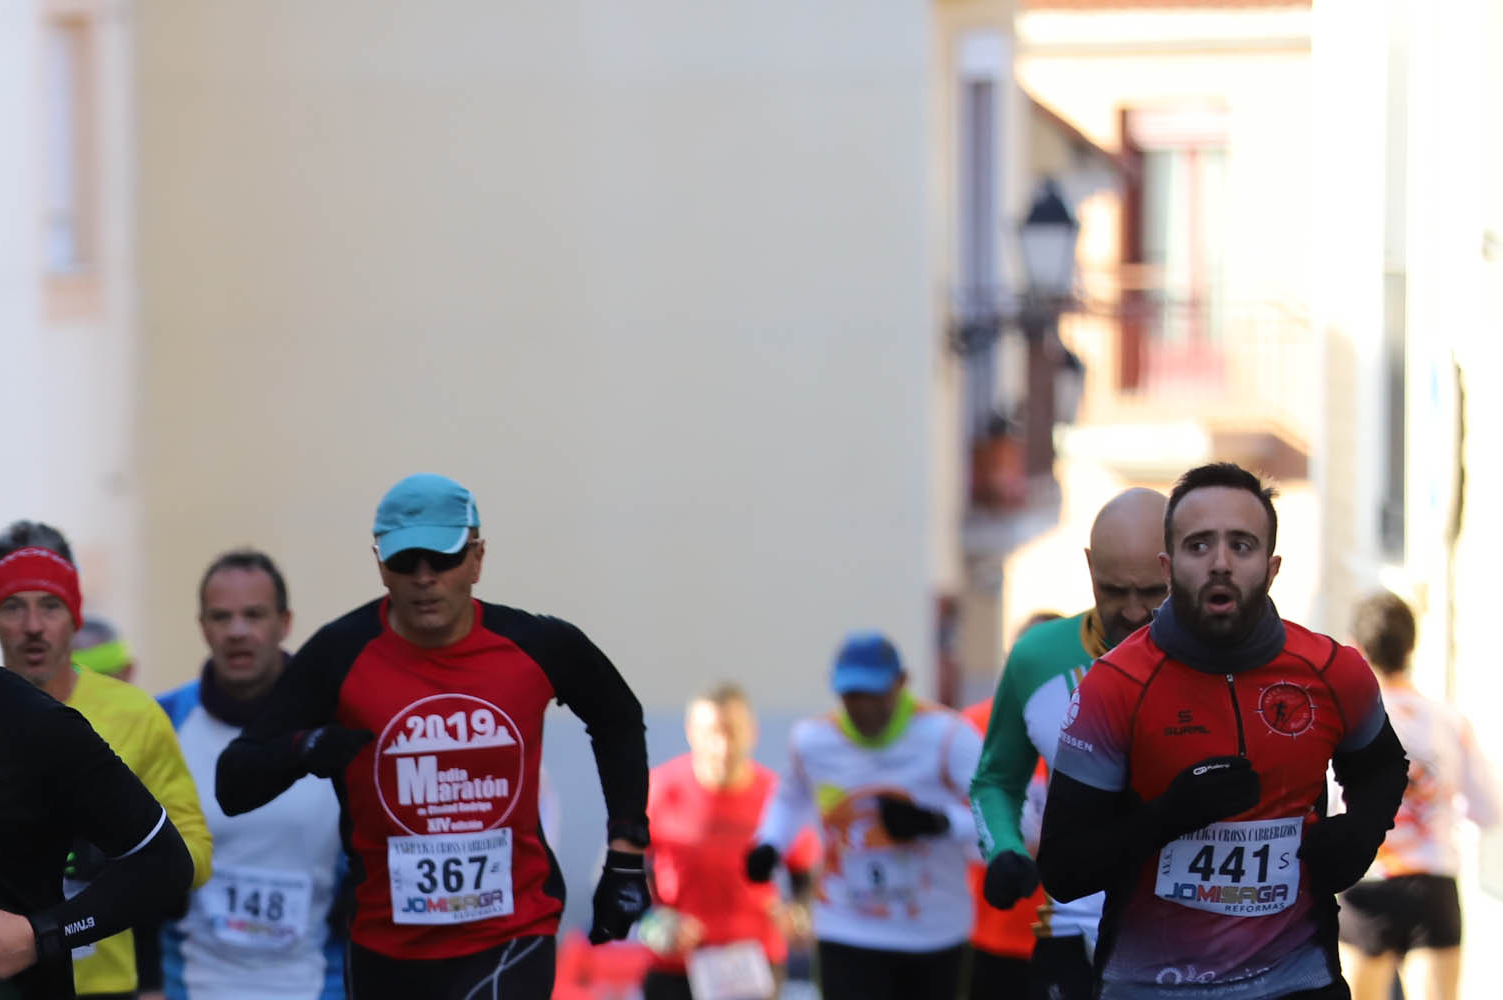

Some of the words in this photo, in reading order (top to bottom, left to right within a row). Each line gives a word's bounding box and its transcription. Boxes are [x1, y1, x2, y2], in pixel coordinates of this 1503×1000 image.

[406, 709, 496, 744] 2019
[1218, 827, 1247, 842] CROSS
[417, 855, 488, 894] 367
[1188, 844, 1270, 883] 441
[225, 886, 285, 921] 148
[1164, 882, 1289, 904] JOMISAGA
[1225, 902, 1286, 913] REFORMAS
